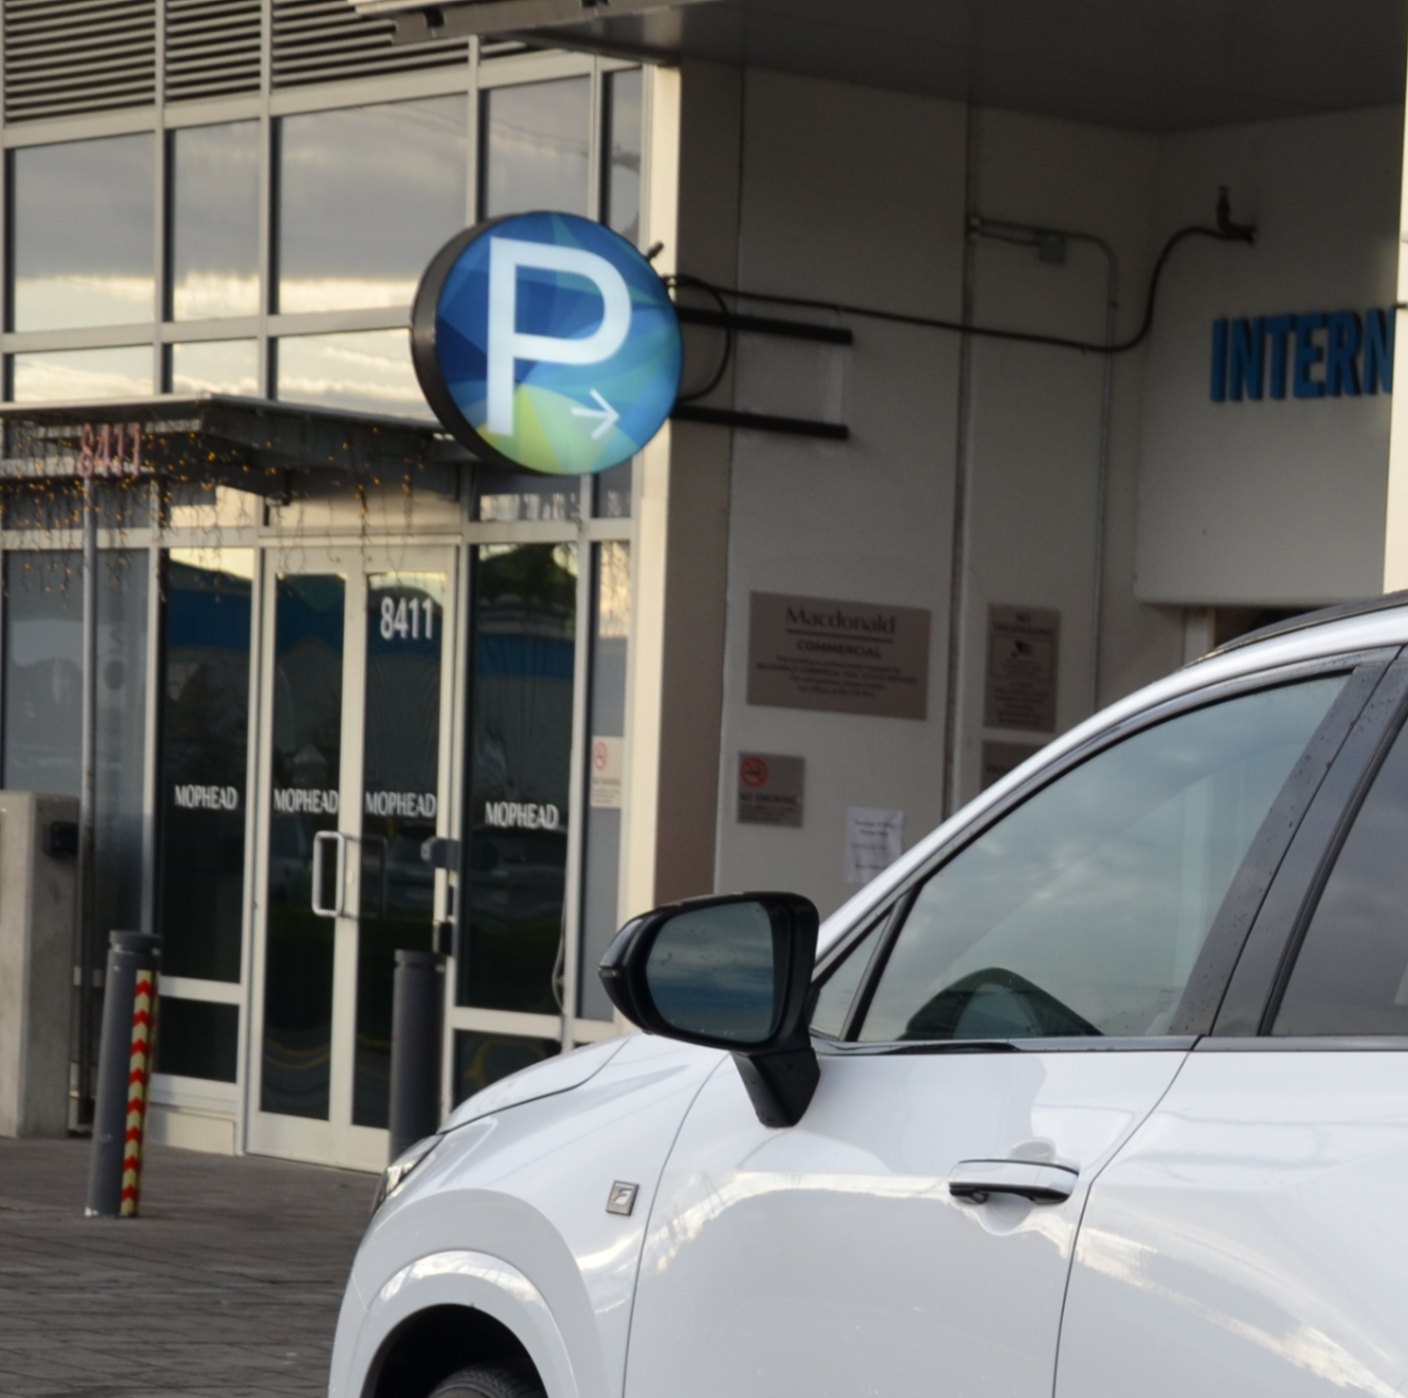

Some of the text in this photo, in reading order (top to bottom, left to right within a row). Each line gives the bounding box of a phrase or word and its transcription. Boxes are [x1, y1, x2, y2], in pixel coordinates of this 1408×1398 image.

[486, 236, 632, 437] P
[1210, 307, 1397, 404] INTERN
[380, 596, 434, 641] 8411
[785, 606, 896, 634] Macdonald
[796, 639, 882, 659] COMMERCIAL
[174, 784, 239, 811] MOPHEAD
[273, 788, 340, 814] MOPHEAD
[365, 791, 437, 818] MOPHEAD
[485, 801, 560, 830] MOPHEAD
